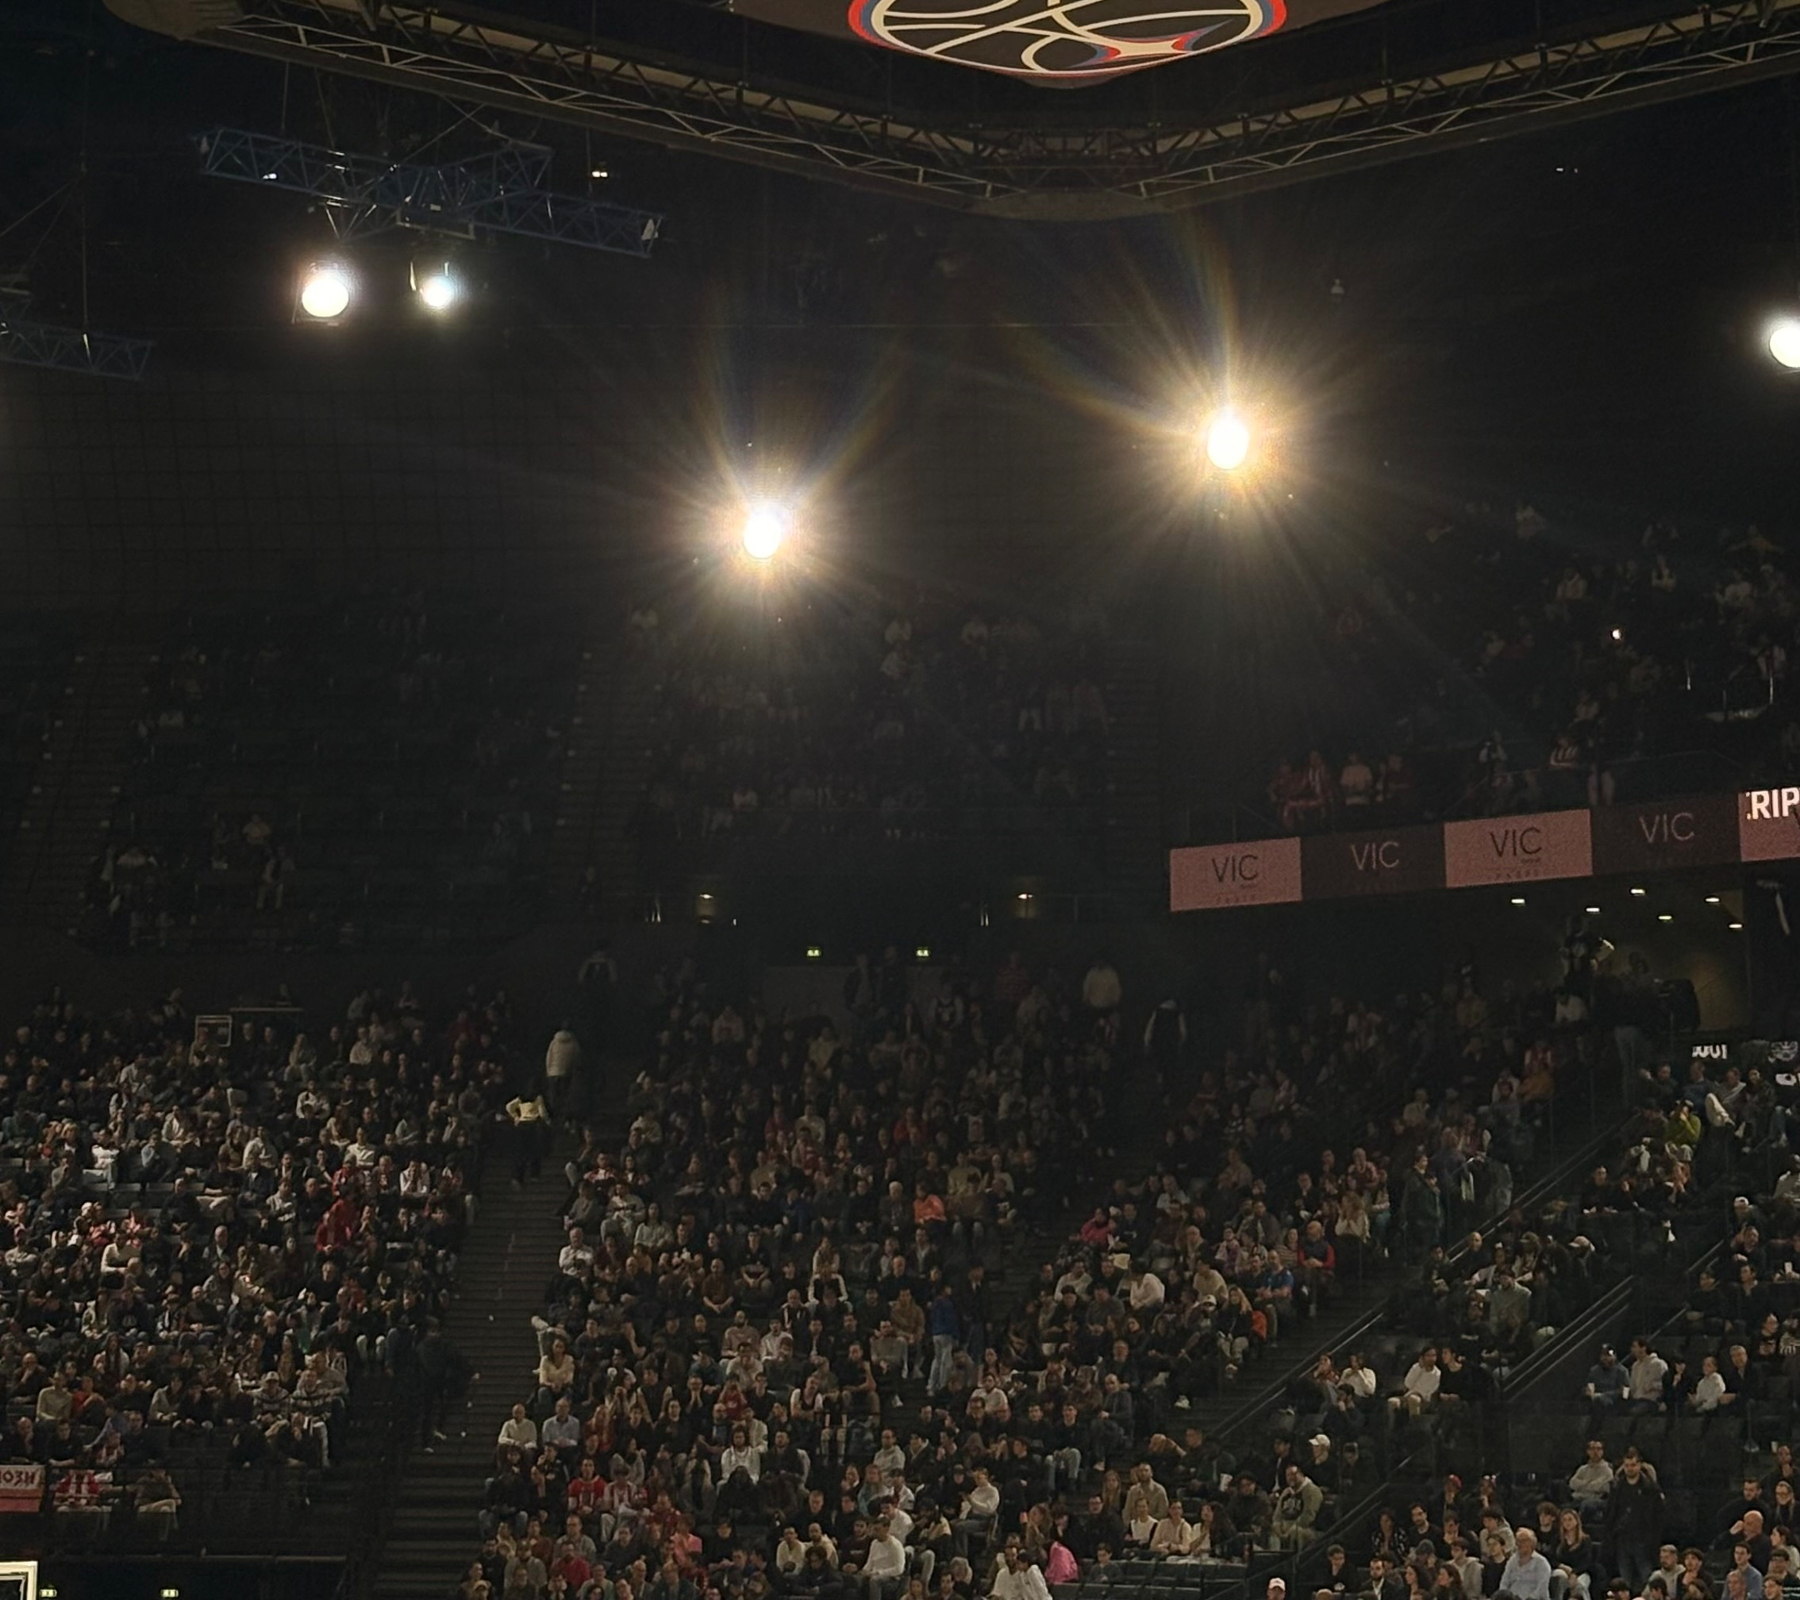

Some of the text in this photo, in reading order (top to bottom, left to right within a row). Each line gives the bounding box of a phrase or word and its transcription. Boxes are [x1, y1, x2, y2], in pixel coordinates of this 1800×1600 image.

[1745, 786, 1800, 820] RIP
[1489, 826, 1543, 858] VIC
[1638, 812, 1696, 844] VIC
[1211, 854, 1260, 882] VIC
[1350, 841, 1400, 871] VIC
